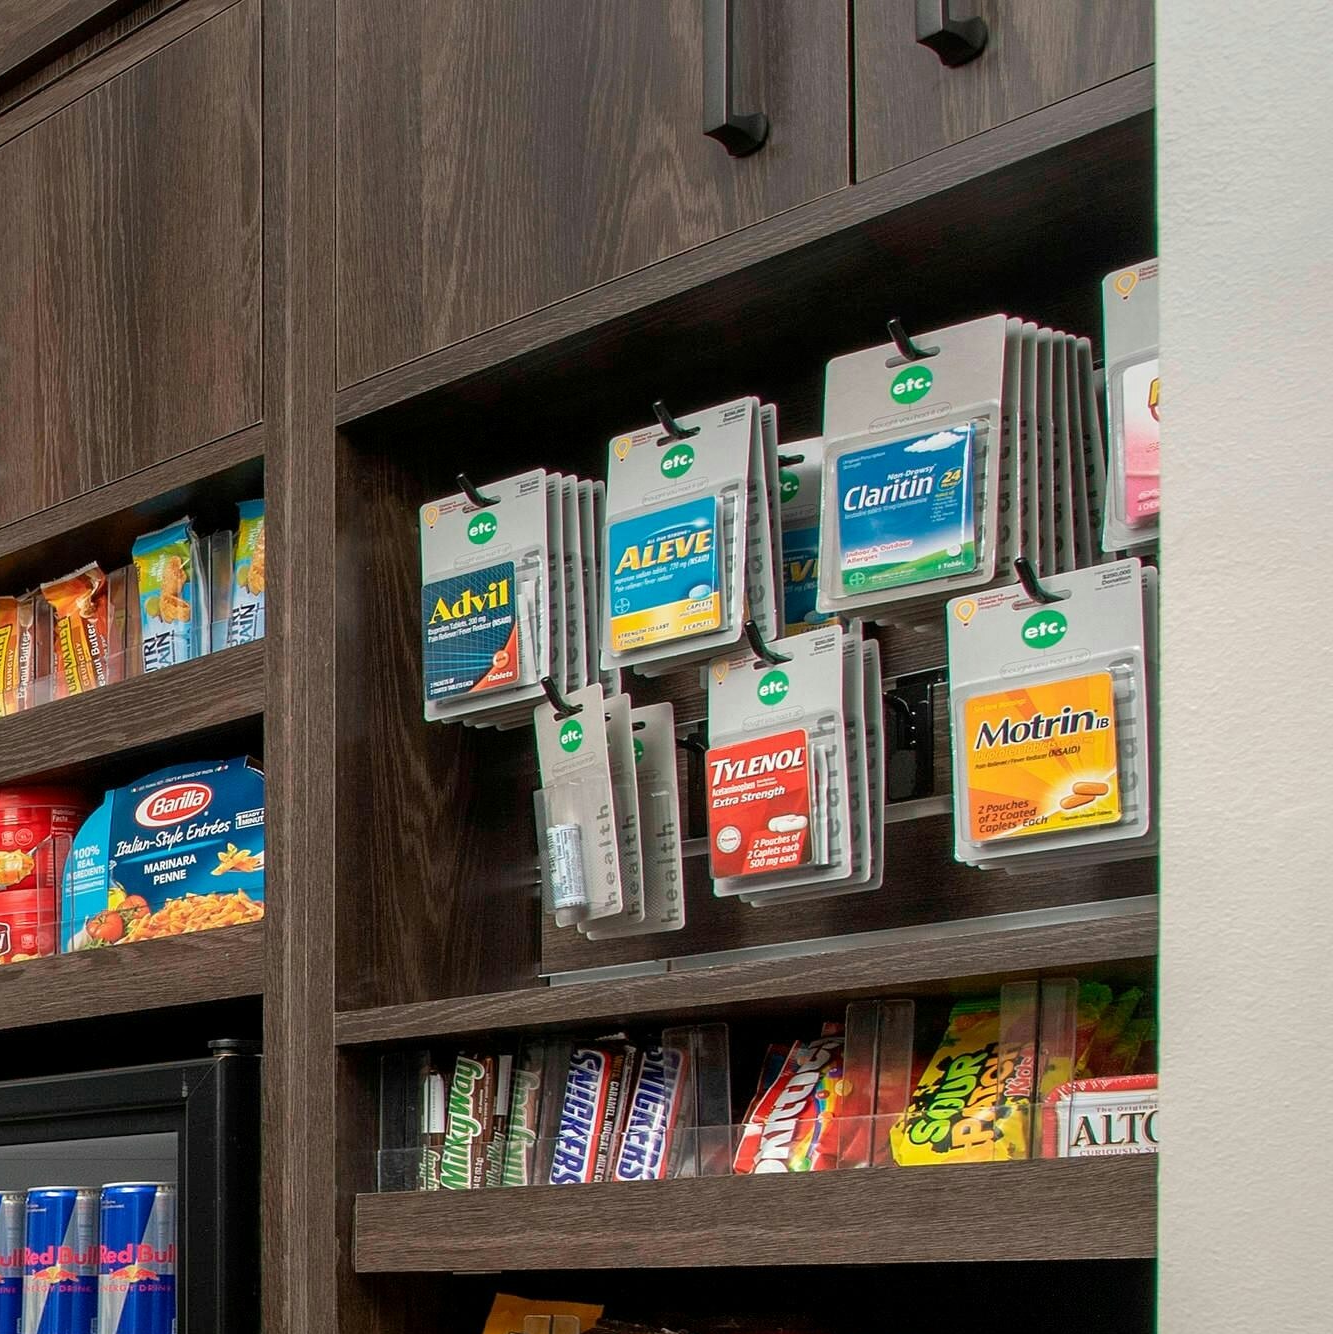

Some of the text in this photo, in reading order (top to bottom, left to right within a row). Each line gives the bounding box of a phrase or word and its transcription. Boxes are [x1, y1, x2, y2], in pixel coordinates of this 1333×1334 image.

[892, 375, 932, 395] etc.
[662, 454, 694, 470] etc.
[887, 464, 936, 480] Non-Drowsy
[941, 469, 962, 483] 24
[843, 474, 935, 512] Claritin
[469, 521, 496, 536] etc.
[615, 529, 712, 575] ALEVE
[429, 579, 508, 625] Advil
[1024, 621, 1067, 639] etc.
[759, 680, 789, 696] etc.
[561, 730, 582, 744] etc.
[975, 707, 1096, 751] Motrin
[710, 747, 805, 786] TYLENOL
[152, 790, 205, 817] Barilla
[712, 786, 785, 809] Extra Strength
[978, 800, 1030, 815] 2 Pouches
[978, 807, 1037, 824] of 2 Coated
[1022, 815, 1048, 827] Each
[115, 819, 231, 857] Italian-Style Entrées
[73, 845, 100, 860] 100%
[77, 859, 95, 869] REAL
[144, 855, 197, 874] MARINARA
[153, 869, 187, 885] PENNE
[911, 1051, 987, 1145] SOUR
[549, 1050, 606, 1185] SNICKERS
[58, 1245, 98, 1265] Bull
